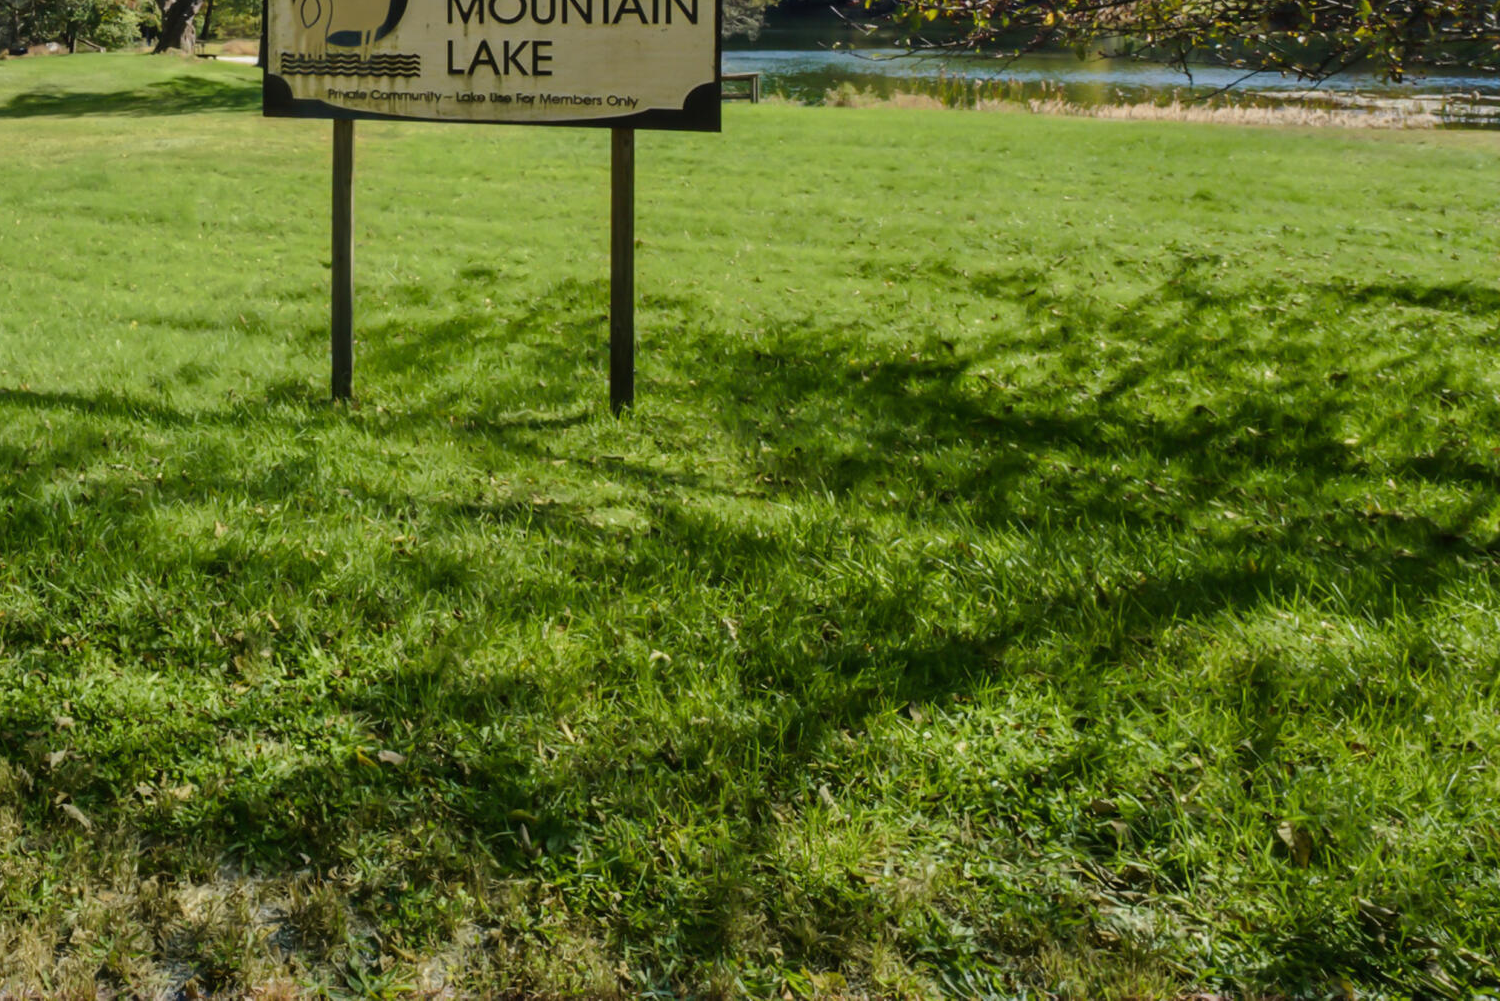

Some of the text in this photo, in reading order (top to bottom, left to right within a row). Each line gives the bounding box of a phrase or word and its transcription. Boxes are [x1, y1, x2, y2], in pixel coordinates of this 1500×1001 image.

[447, 40, 553, 76] LAKE
[327, 89, 367, 100] Private
[371, 90, 441, 103] Community
[456, 91, 485, 103] Lake
[490, 92, 511, 104] Use
[516, 93, 534, 104] For
[539, 94, 602, 106] Members
[607, 95, 638, 108] Only
